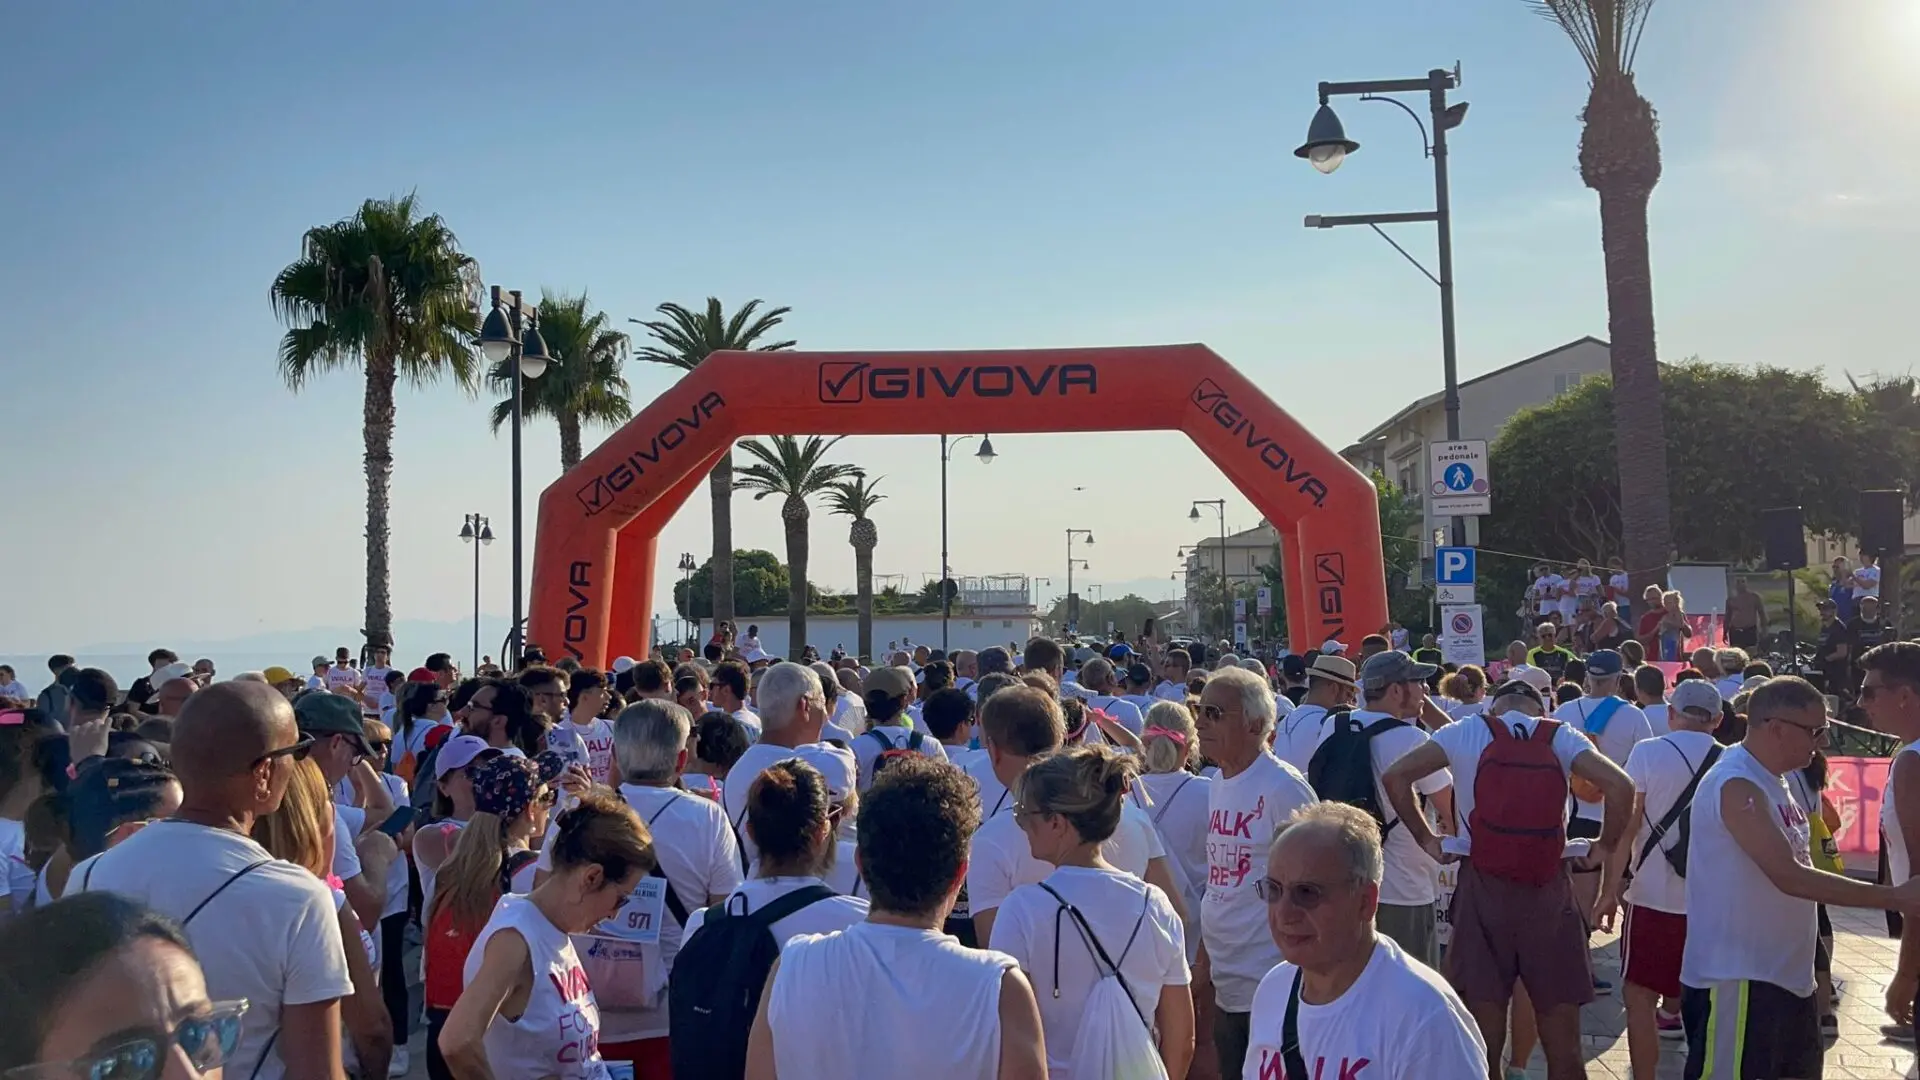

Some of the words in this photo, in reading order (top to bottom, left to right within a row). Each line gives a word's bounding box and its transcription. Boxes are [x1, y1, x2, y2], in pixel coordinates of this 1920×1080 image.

[868, 364, 1097, 399] GIVOVA
[606, 391, 725, 492] GIVOVA
[1213, 402, 1328, 506] GIVOVA
[1438, 452, 1479, 461] pedonale
[1443, 552, 1467, 580] P
[1208, 809, 1255, 839] ALK
[628, 911, 651, 930] 971
